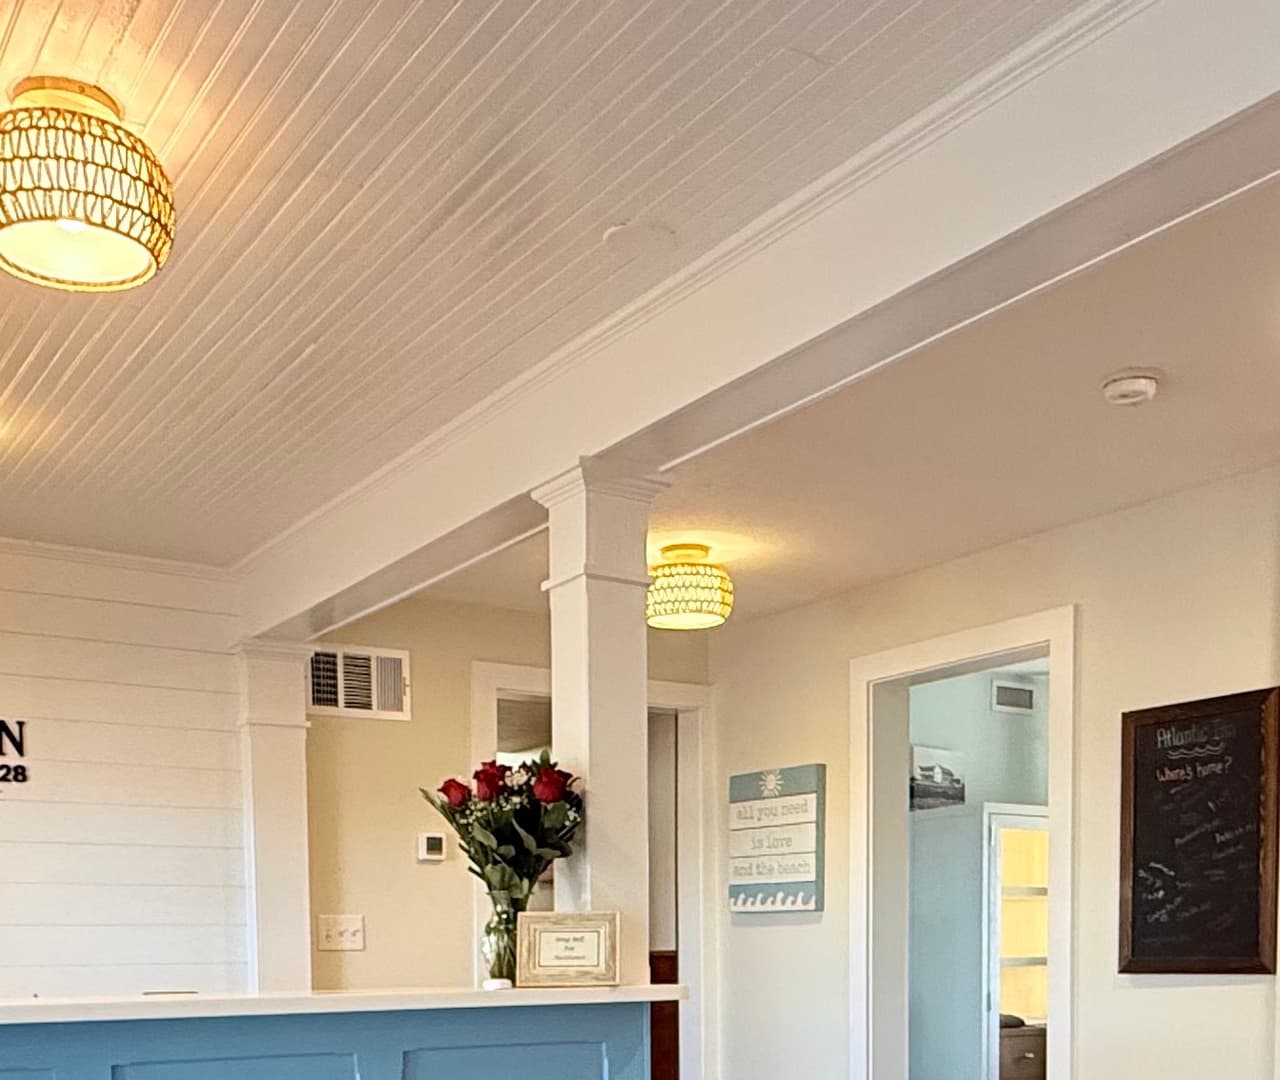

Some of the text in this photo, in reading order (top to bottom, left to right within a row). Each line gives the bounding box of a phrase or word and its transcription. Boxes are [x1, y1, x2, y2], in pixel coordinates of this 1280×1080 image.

[1157, 724, 1208, 749] Atlantic
[736, 800, 808, 822] all you need
[751, 834, 793, 850] is love
[733, 860, 811, 877] and the beach
